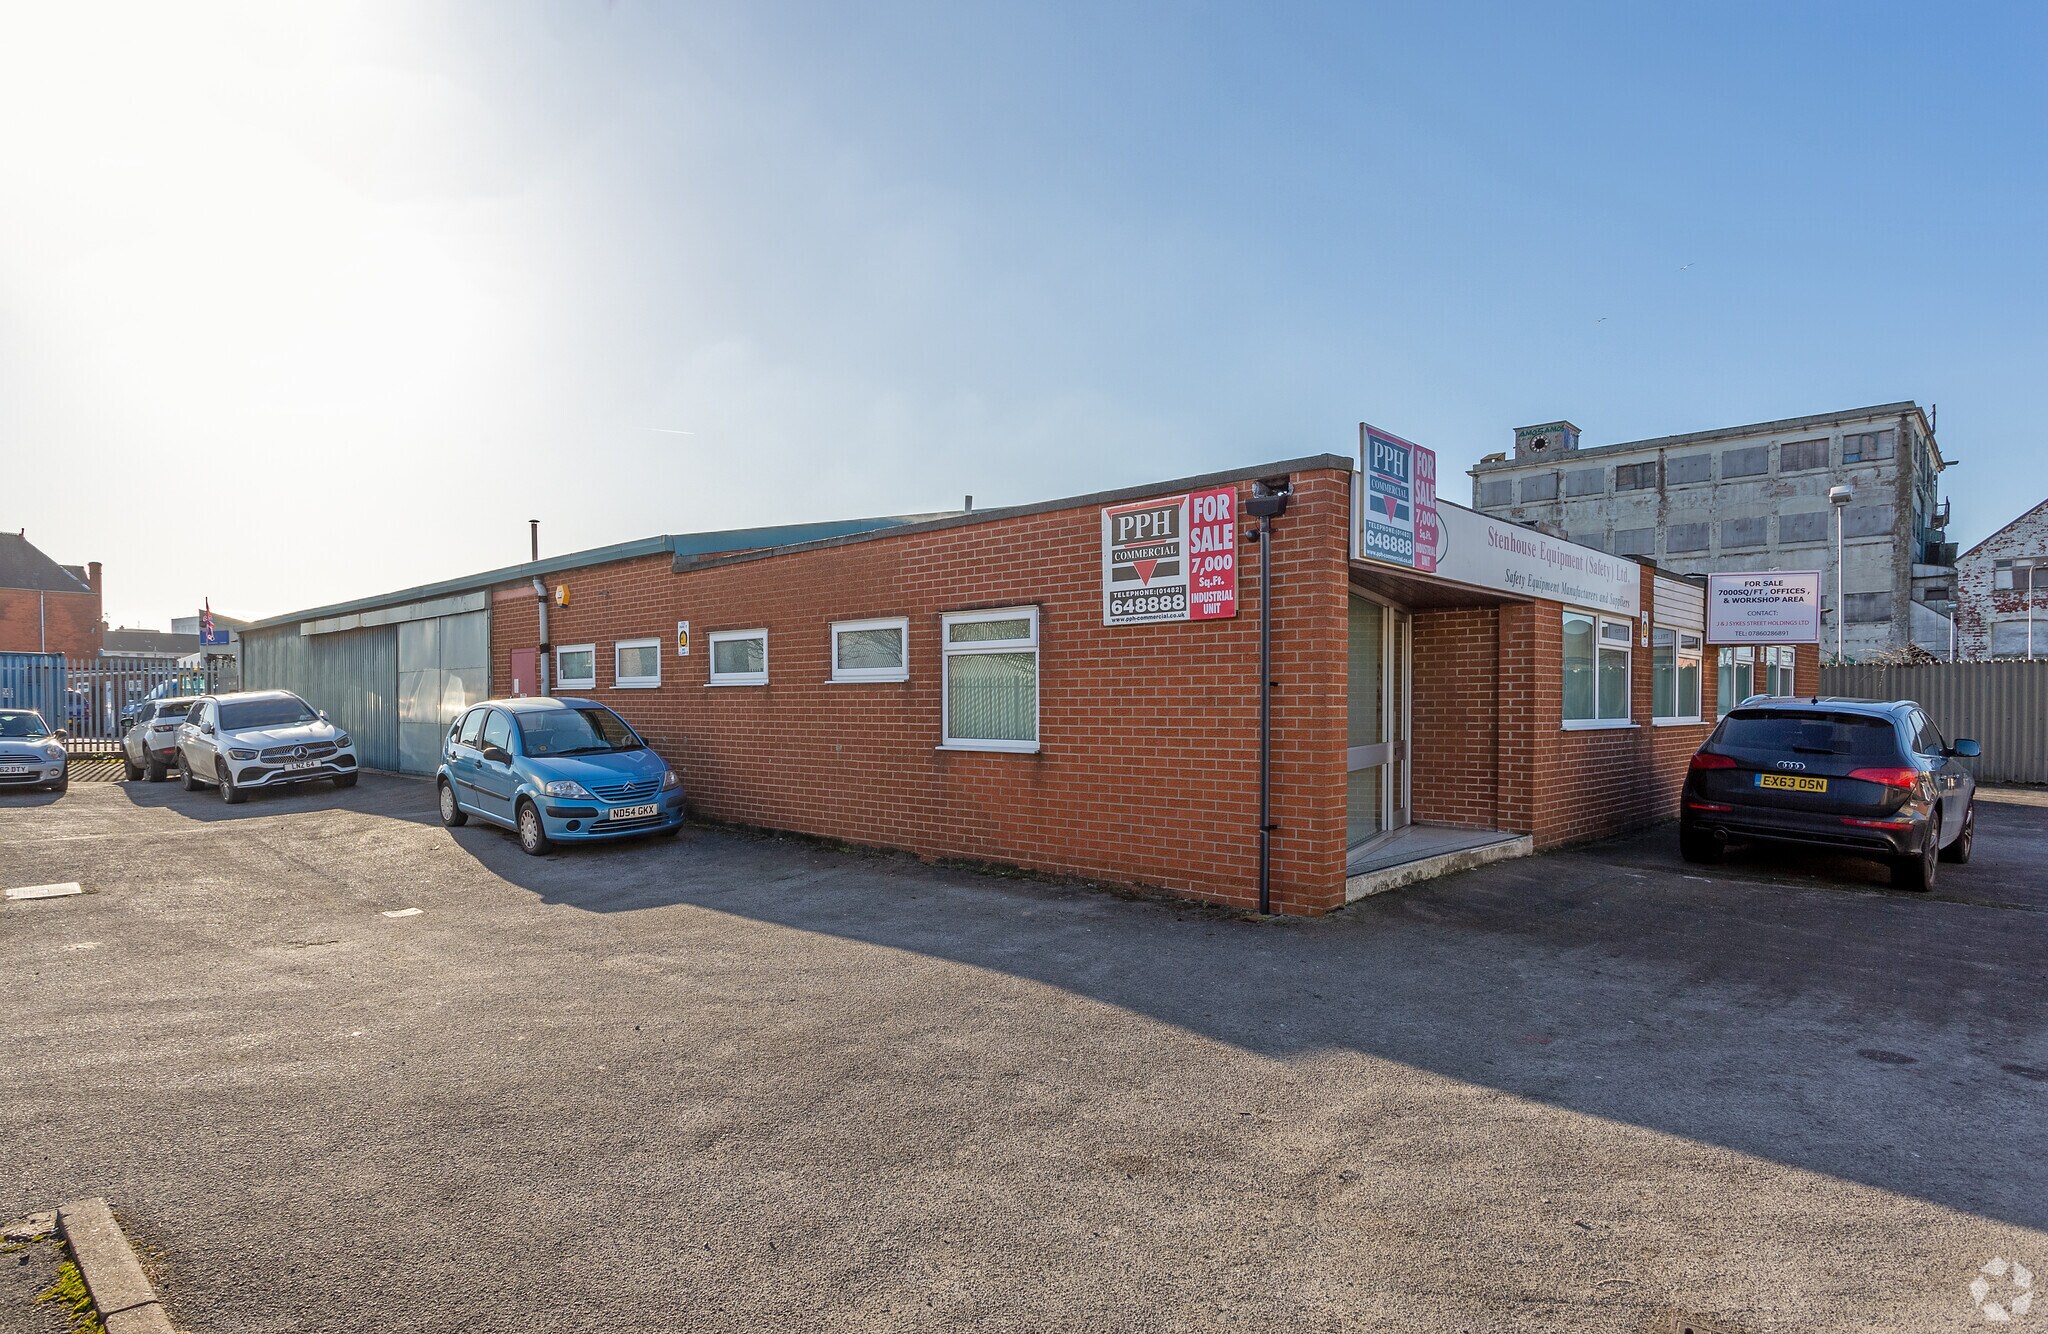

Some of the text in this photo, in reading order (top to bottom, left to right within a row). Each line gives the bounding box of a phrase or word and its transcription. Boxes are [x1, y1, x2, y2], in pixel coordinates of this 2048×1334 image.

[1373, 441, 1405, 478] PPH
[1416, 450, 1434, 480] FOR
[1371, 479, 1407, 499] COMMERCIAL
[1415, 479, 1436, 509] SALE
[1193, 493, 1230, 524] FOR
[1415, 509, 1436, 528] 7,000
[1118, 509, 1172, 541] PPH
[1190, 523, 1233, 554] SALE
[1366, 530, 1412, 556] 648888
[1114, 546, 1177, 562] COMMERCIAL
[1488, 525, 1630, 583] Stenhouse Equipment (Safety) Ltd.
[1191, 554, 1233, 576] 7,000
[1198, 575, 1225, 588] Sq.Ft.
[1505, 568, 1630, 609] Safety Equipment Manufacturers and Suppliers
[1111, 594, 1185, 615] 648888
[1191, 590, 1233, 604] INDUSTRIAL
[1111, 612, 1185, 623] www.pph-commercial.co.uk
[1203, 602, 1221, 615] UNIT
[1763, 776, 1825, 790] EX63 OSN
[613, 805, 654, 818] ND54 GKX
